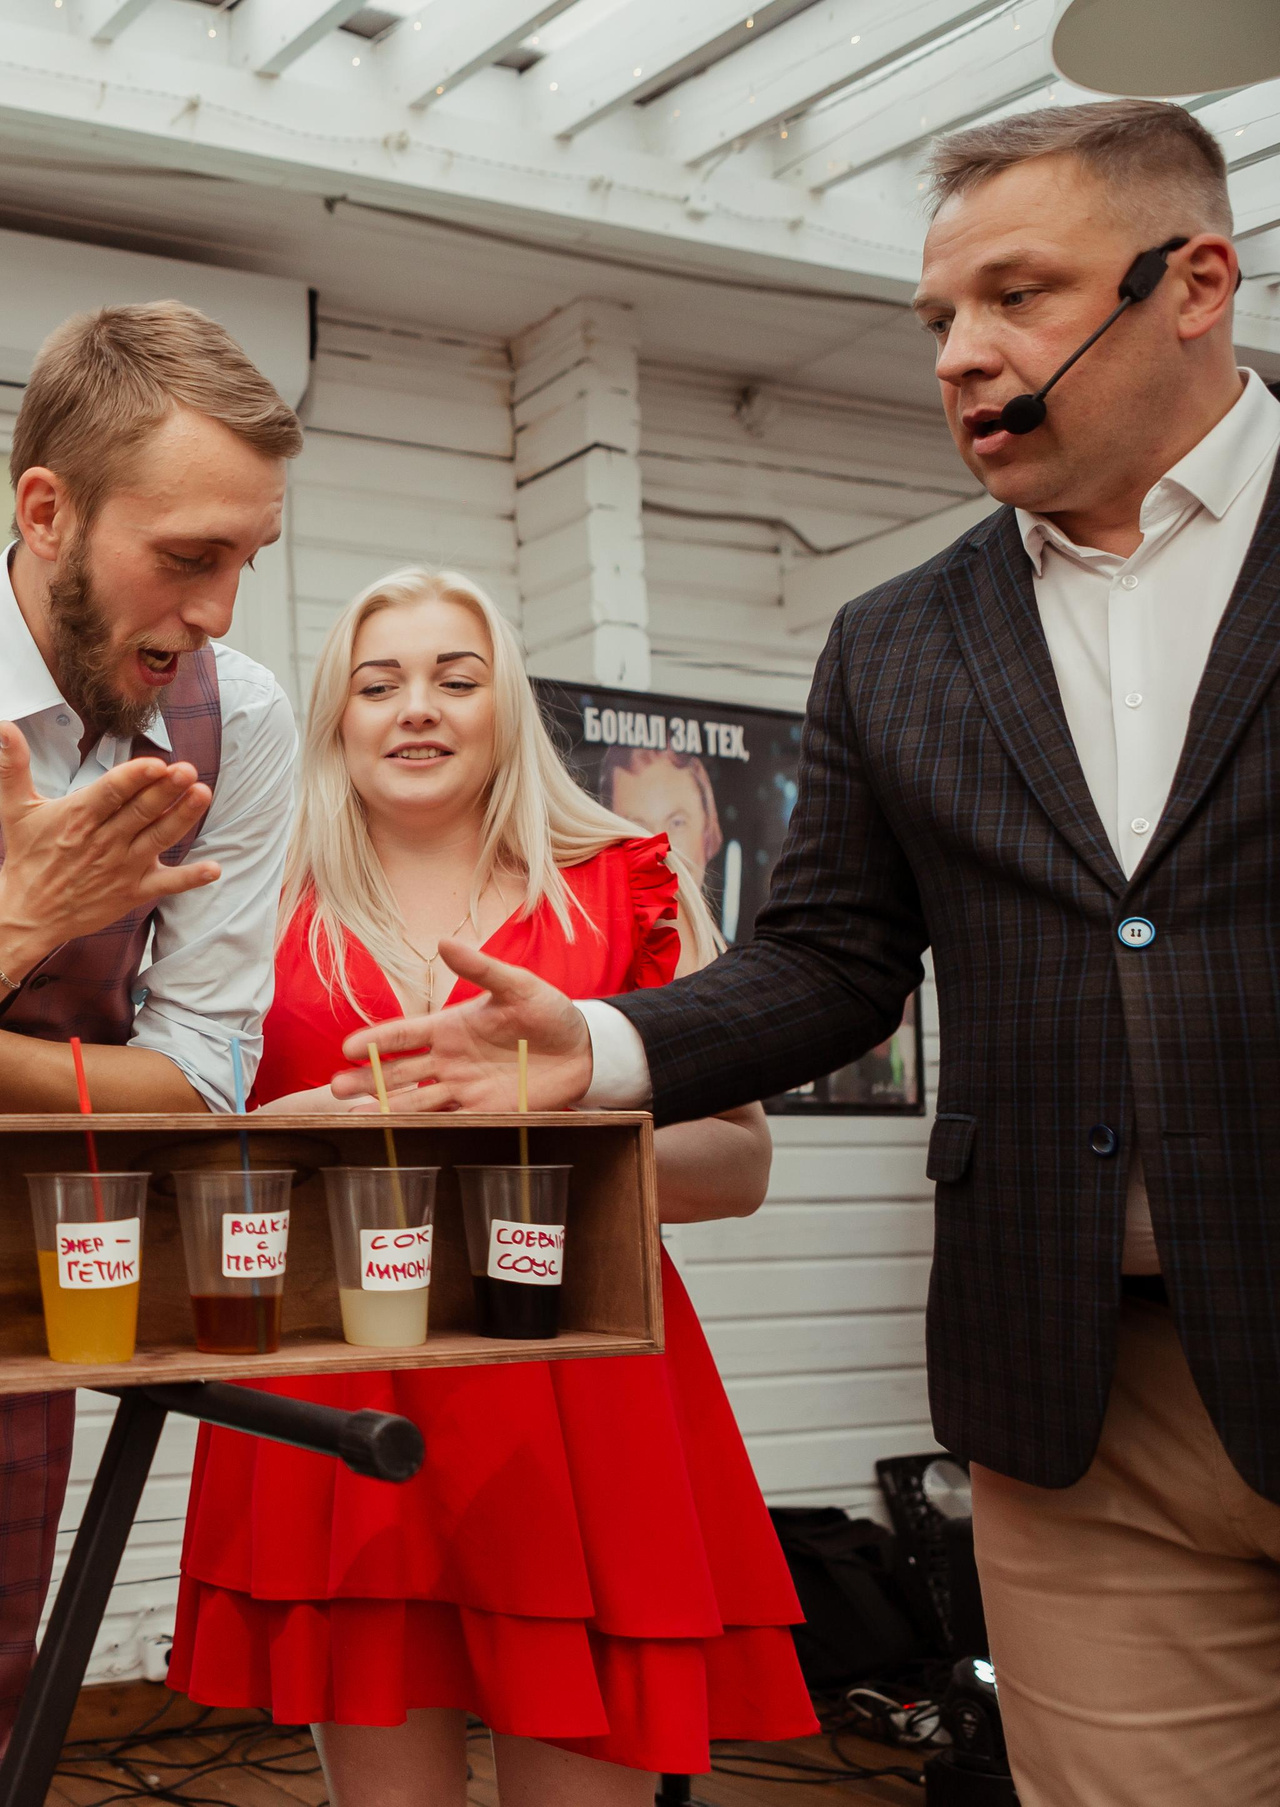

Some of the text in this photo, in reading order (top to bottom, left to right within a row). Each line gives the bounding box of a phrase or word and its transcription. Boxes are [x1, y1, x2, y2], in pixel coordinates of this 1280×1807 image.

[583, 706, 667, 750] БОКАЛ
[669, 717, 703, 755] ЗА
[370, 1229, 430, 1251] СОК
[67, 1260, 136, 1283] ГЕТИК
[496, 1252, 559, 1277] СОУС
